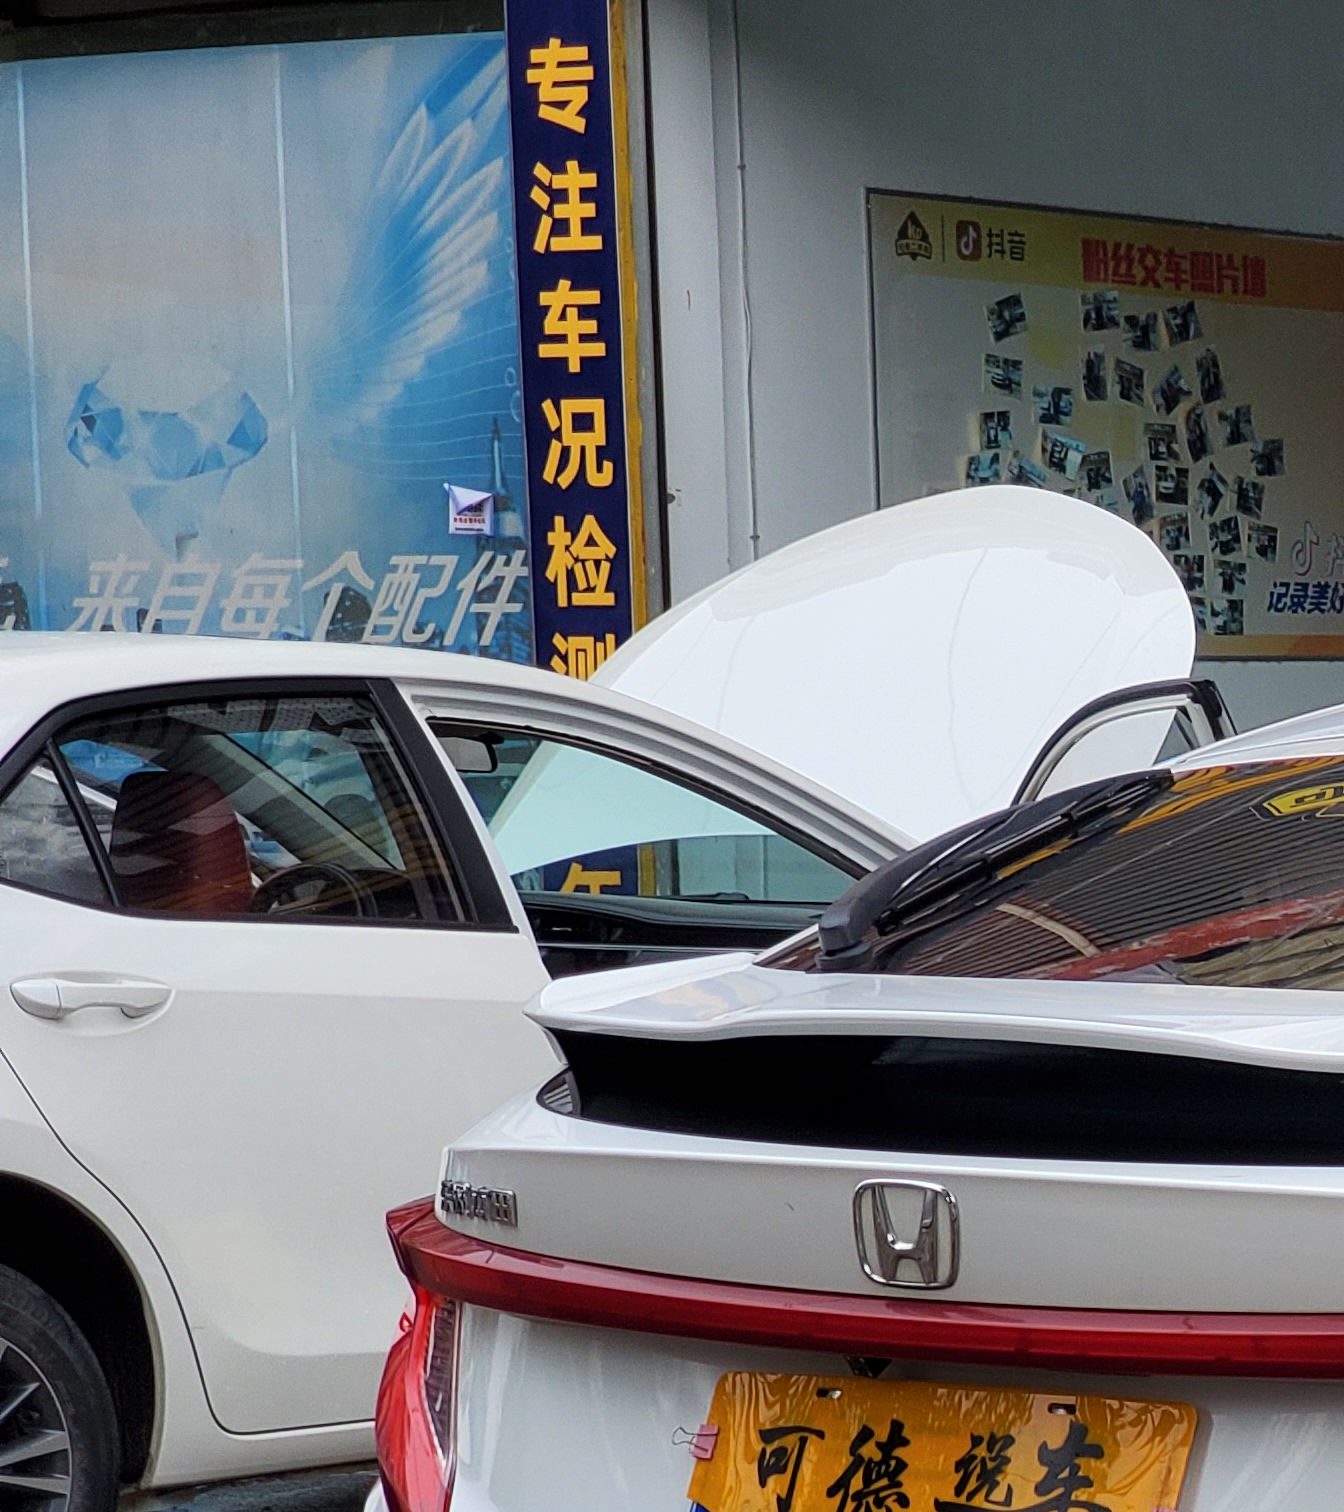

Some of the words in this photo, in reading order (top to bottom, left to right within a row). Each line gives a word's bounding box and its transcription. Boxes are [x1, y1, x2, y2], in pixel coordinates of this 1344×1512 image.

[987, 228, 1027, 261] 抖音
[65, 551, 530, 646] 来自每个配件
